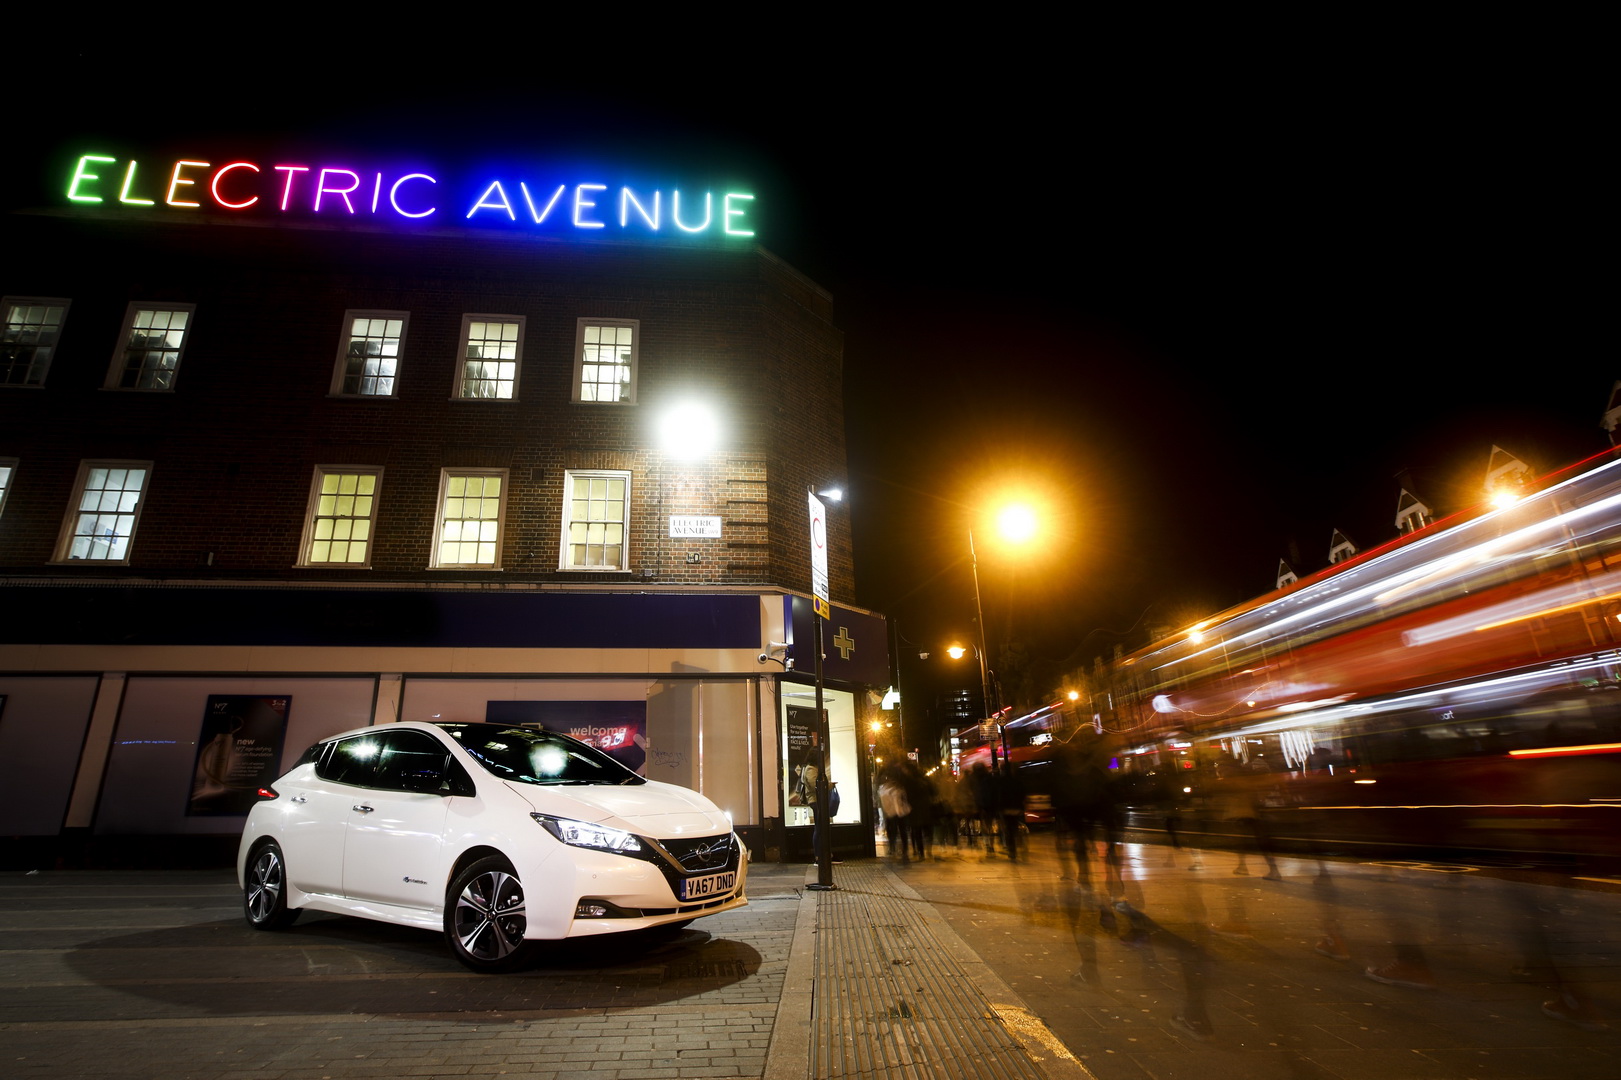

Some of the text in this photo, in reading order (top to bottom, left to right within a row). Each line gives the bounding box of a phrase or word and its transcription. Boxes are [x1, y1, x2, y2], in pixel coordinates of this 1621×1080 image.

[66, 154, 756, 237] ELECTRIC AVENUE
[673, 519, 715, 527] ELECTRIC
[673, 527, 707, 535] AVENUE
[570, 725, 627, 736] welcome
[716, 873, 734, 891] DND
